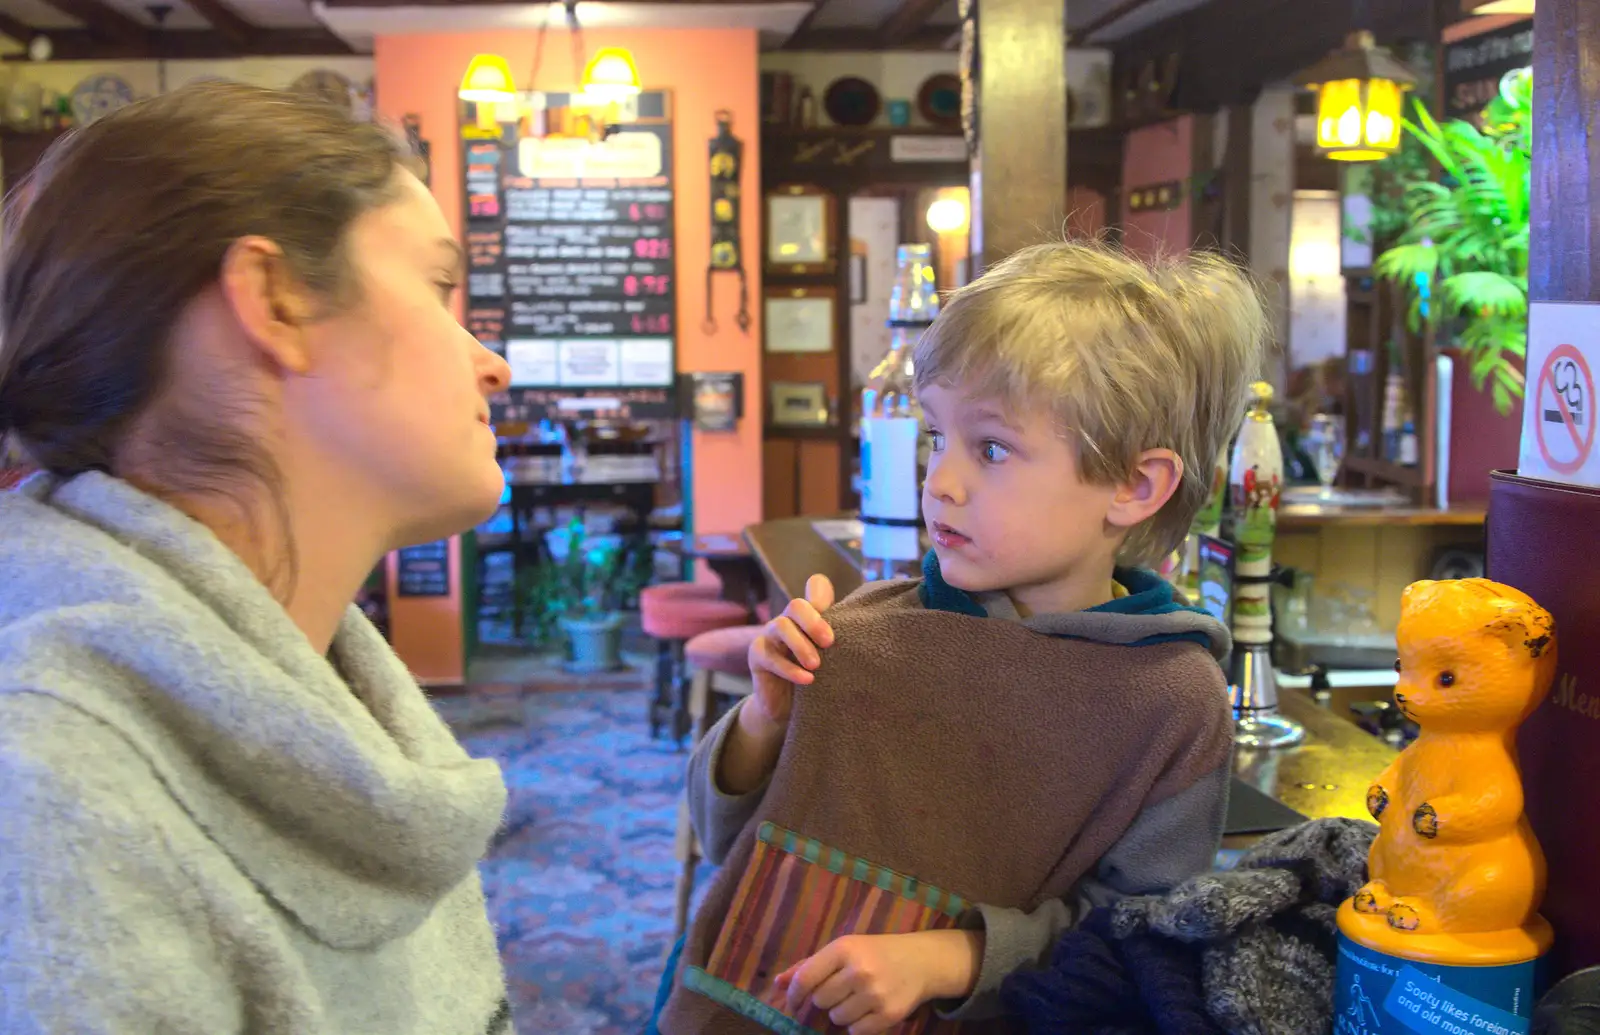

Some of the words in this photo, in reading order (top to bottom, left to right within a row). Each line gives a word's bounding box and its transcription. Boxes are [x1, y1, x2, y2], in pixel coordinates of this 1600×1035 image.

[1397, 995, 1422, 1014] and
[1420, 1009, 1442, 1026] old
[1404, 980, 1440, 1009] Sooty
[1440, 1000, 1468, 1022] likes
